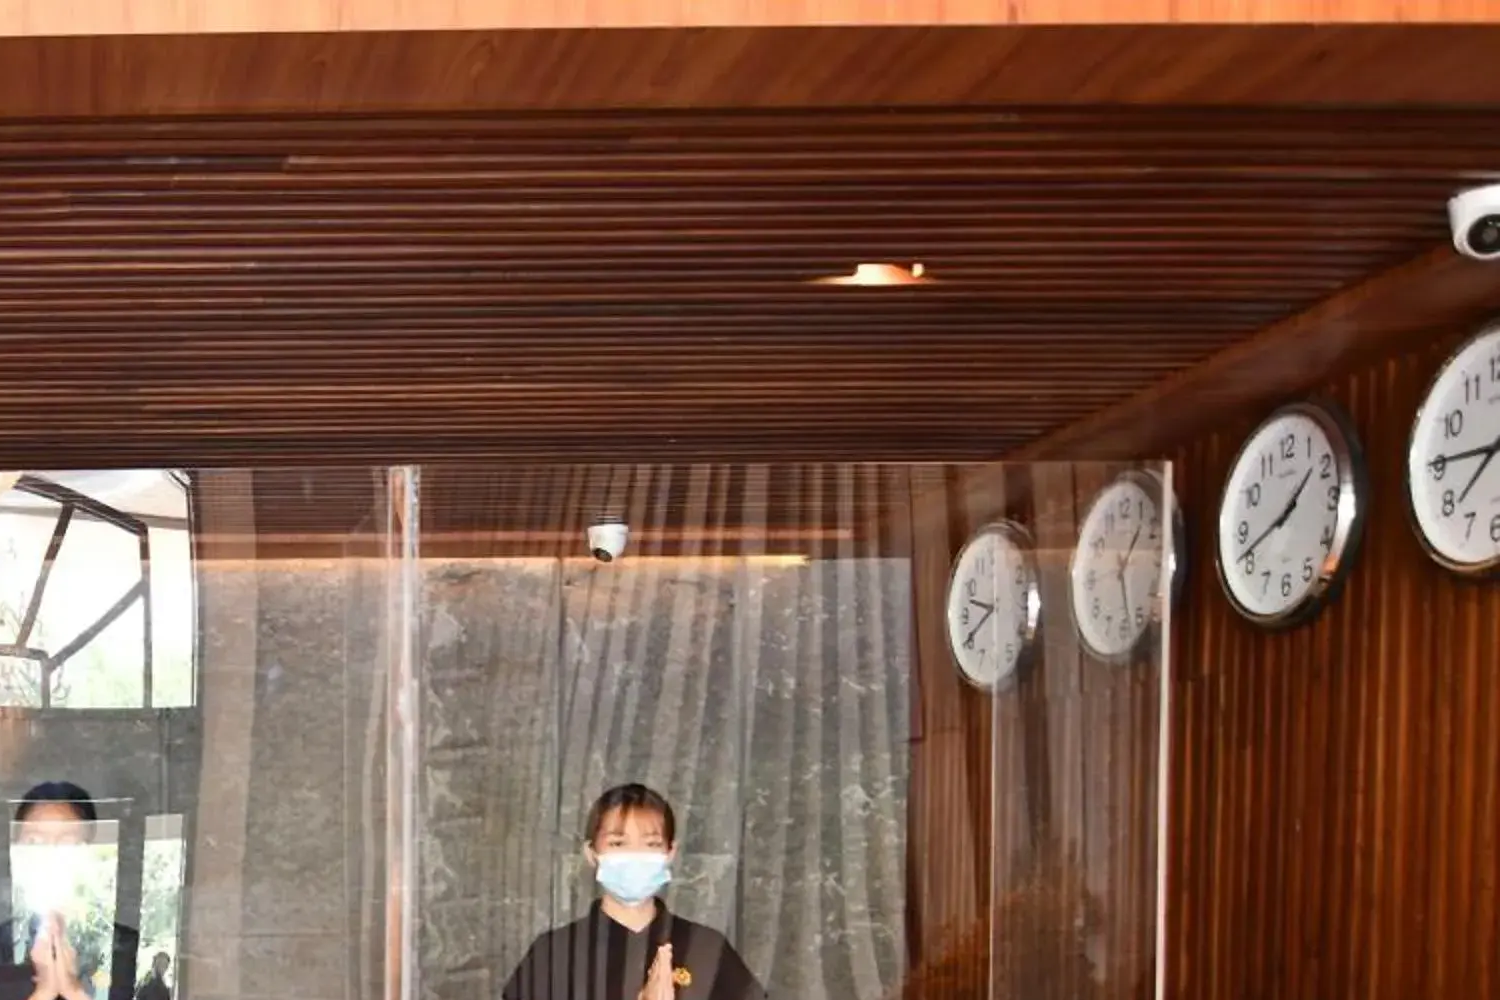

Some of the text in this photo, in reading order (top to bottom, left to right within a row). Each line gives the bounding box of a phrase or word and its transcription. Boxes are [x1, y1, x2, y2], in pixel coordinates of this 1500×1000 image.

[1463, 373, 1481, 406] 11
[1444, 409, 1464, 439] 10
[1278, 434, 1296, 460] 12
[1260, 454, 1274, 479] 11
[1320, 453, 1332, 479] 2
[1245, 482, 1262, 509] 10
[1327, 485, 1341, 512] 3
[1441, 490, 1455, 517] 8
[1237, 520, 1249, 545] 9
[1463, 511, 1477, 541] 7
[1244, 549, 1256, 575] 8
[1301, 557, 1313, 582] 5
[1260, 571, 1272, 596] 7
[1280, 573, 1293, 597] 6
